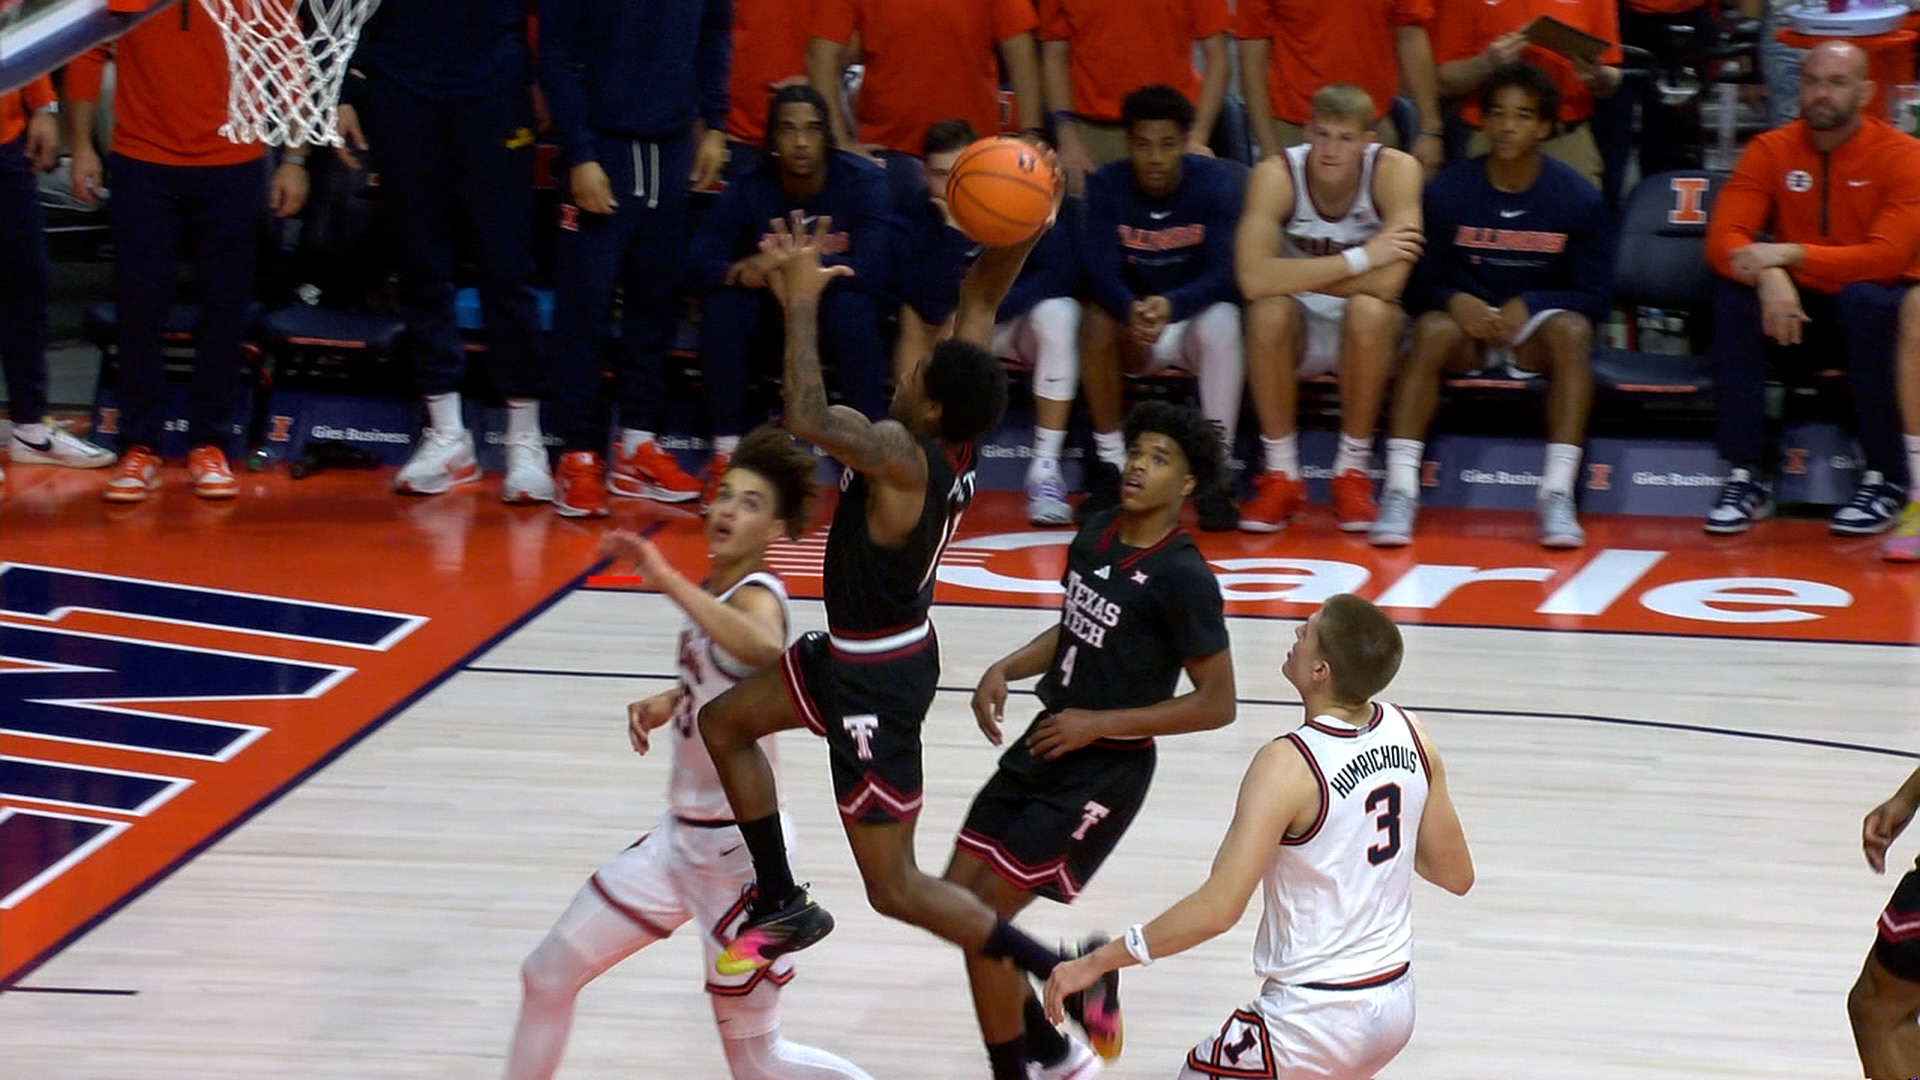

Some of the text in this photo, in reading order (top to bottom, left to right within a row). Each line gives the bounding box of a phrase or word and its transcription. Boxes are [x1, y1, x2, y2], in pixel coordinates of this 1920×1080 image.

[1668, 178, 1710, 224] I
[268, 415, 294, 441] I
[311, 425, 411, 444] Gies Business
[1460, 469, 1495, 484] Gies
[1586, 463, 1614, 491] I
[1631, 471, 1667, 486] Gies
[1065, 569, 1122, 628] TEXAS
[1062, 597, 1107, 649] TECH
[1060, 645, 1079, 688] 4
[1330, 744, 1418, 800] HUMRICHOUS
[1364, 781, 1402, 868] 3
